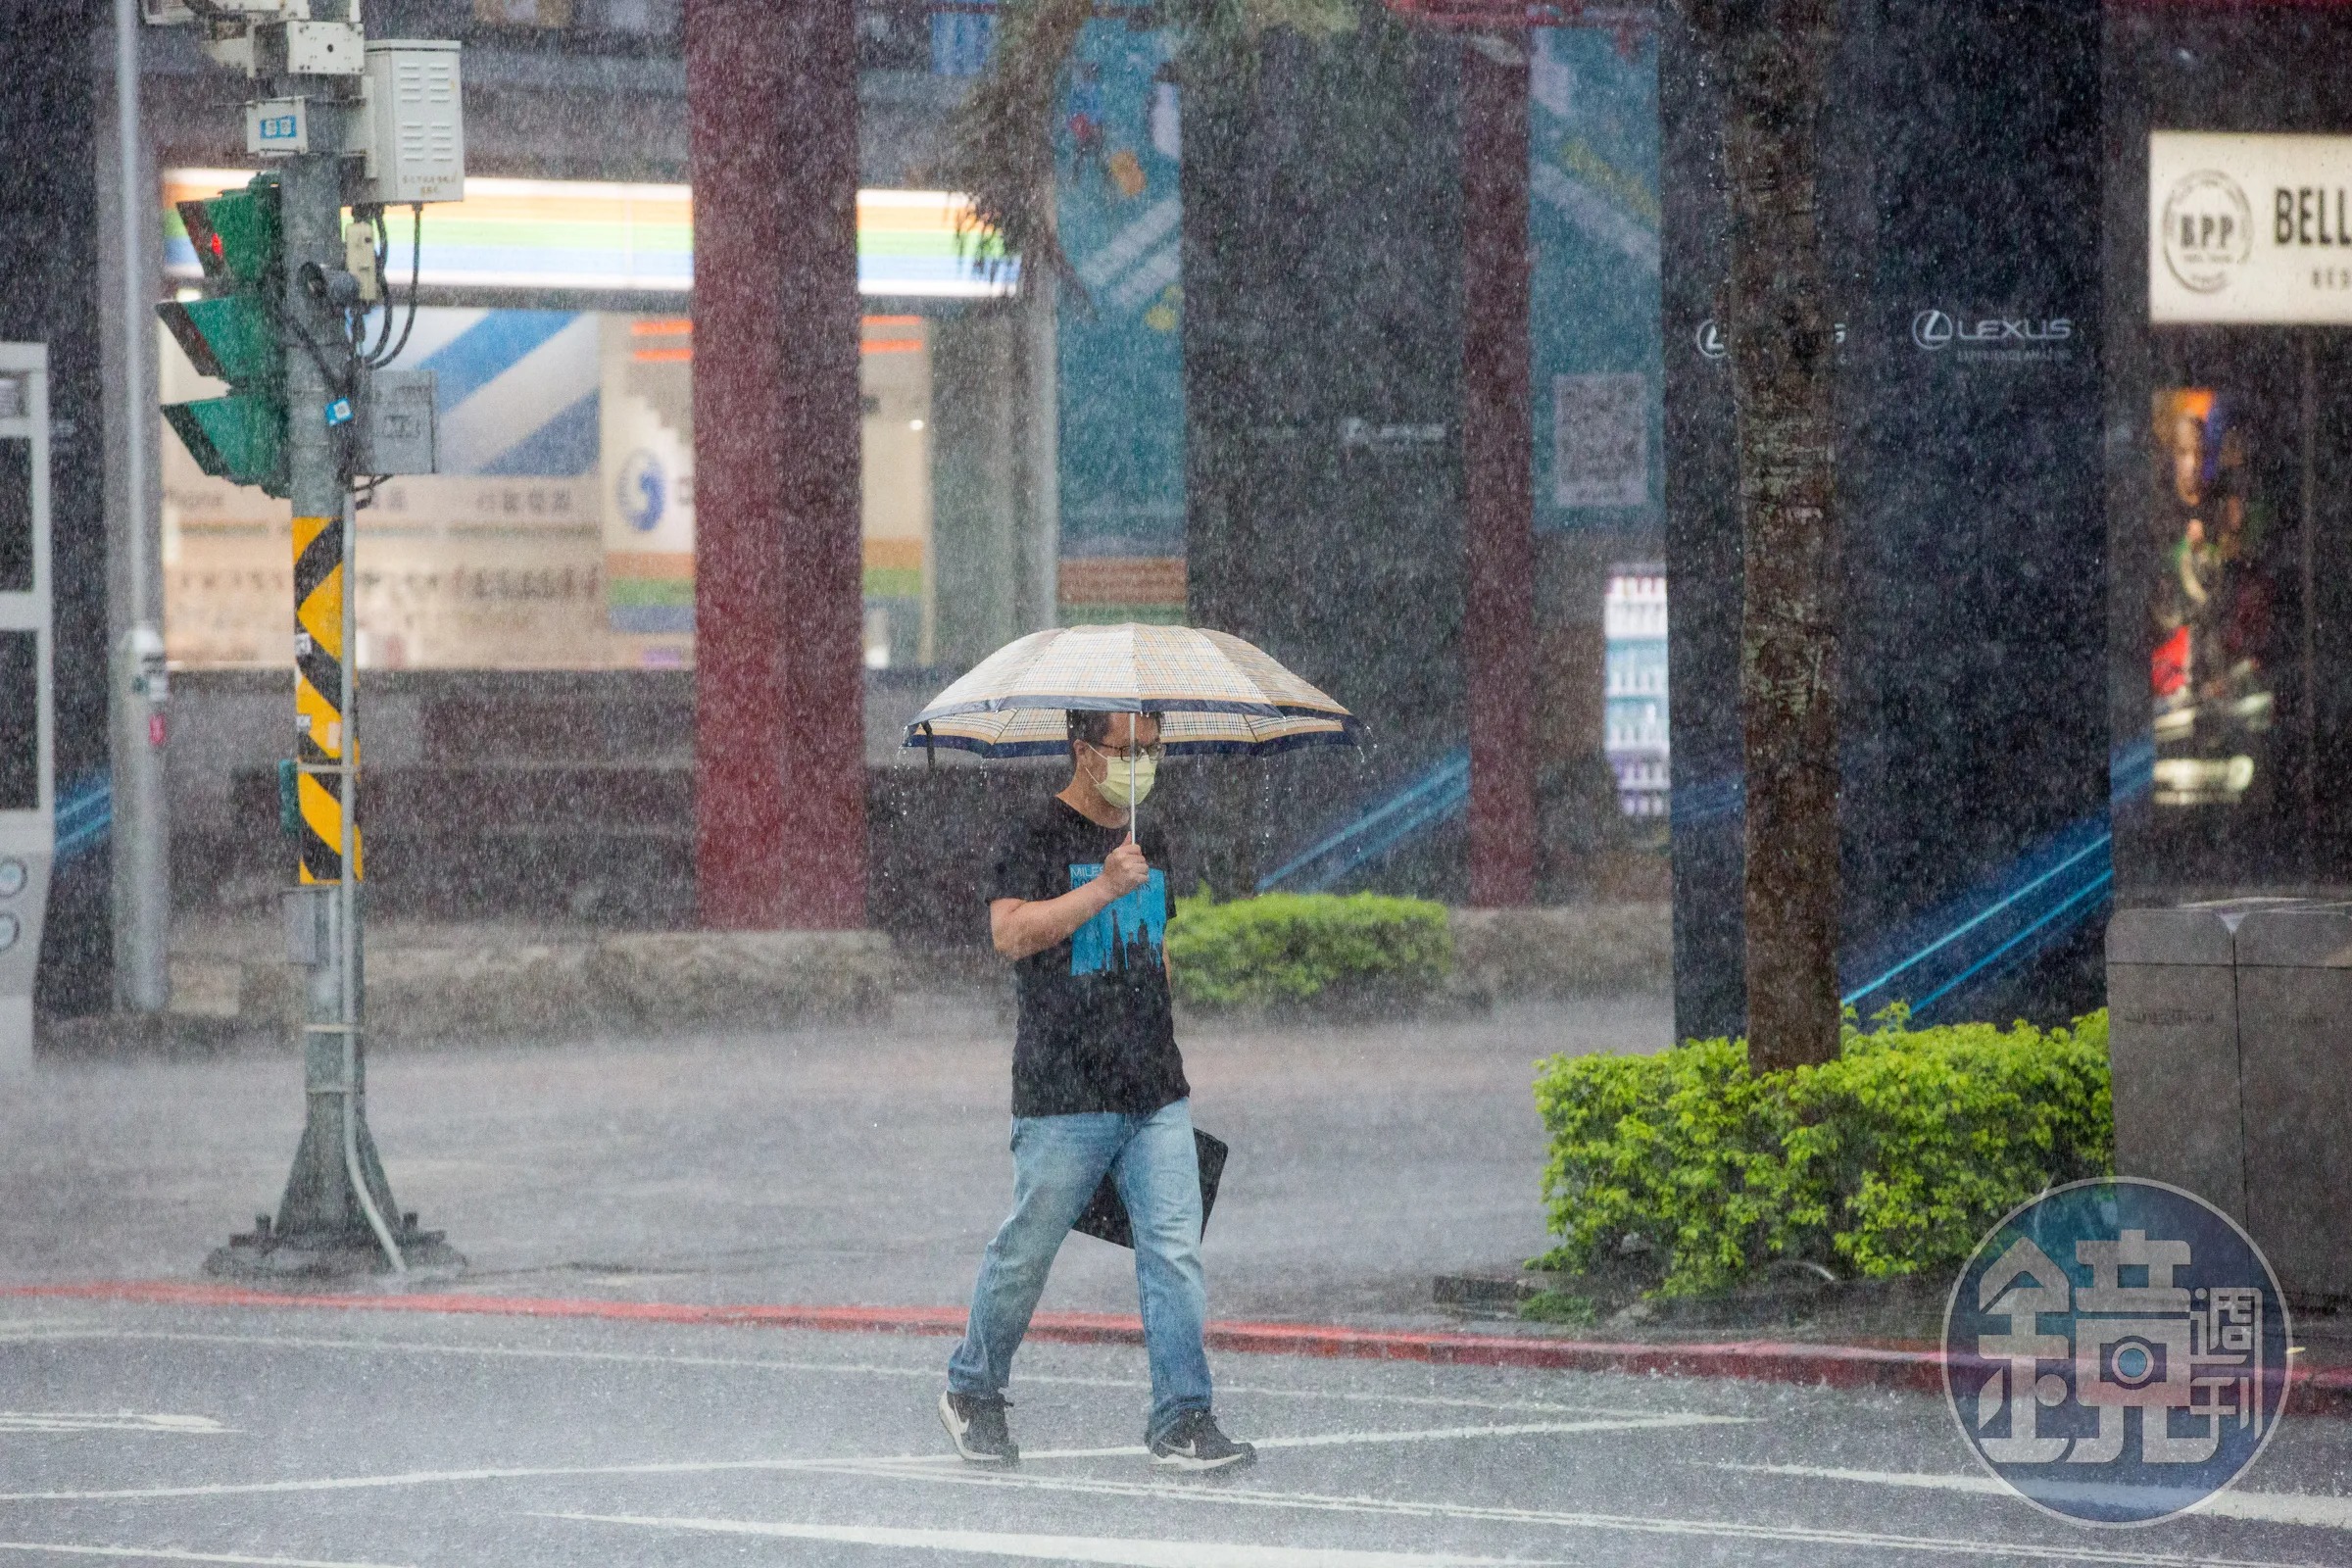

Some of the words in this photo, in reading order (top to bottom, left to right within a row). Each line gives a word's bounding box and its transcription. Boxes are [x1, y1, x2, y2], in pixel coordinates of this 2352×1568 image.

[2180, 215, 2234, 249] BPP
[2275, 186, 2352, 246] BELL
[1957, 317, 2073, 341] LEXUS
